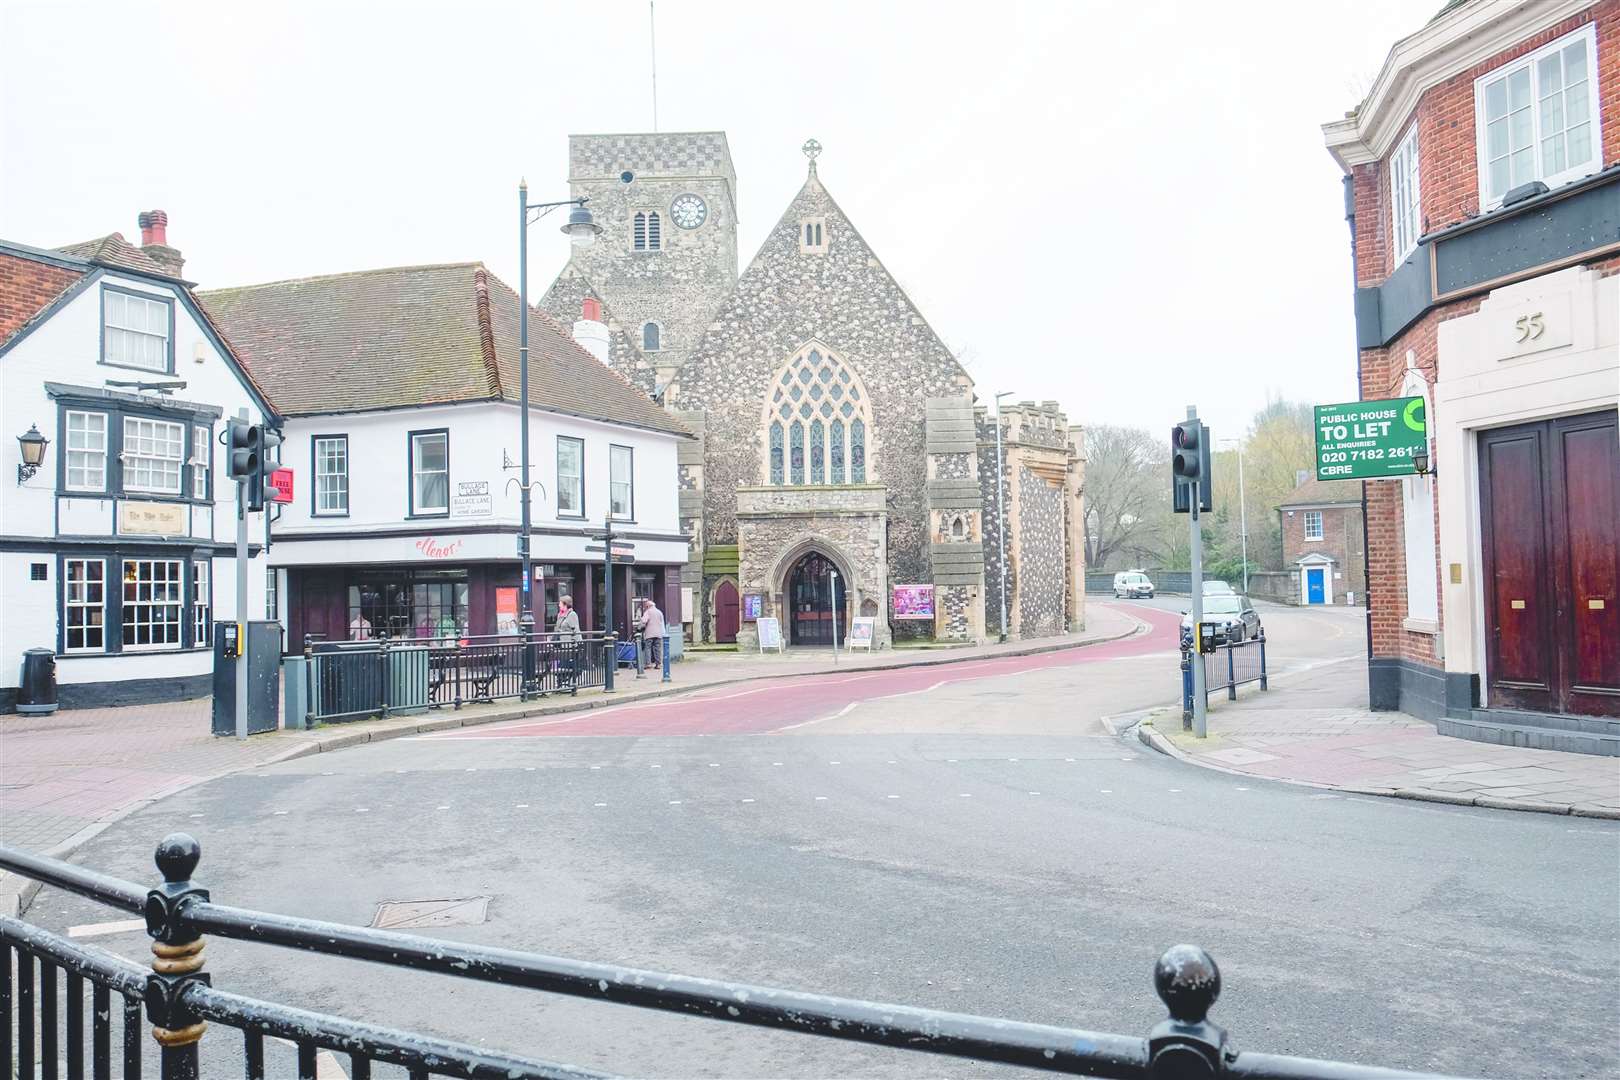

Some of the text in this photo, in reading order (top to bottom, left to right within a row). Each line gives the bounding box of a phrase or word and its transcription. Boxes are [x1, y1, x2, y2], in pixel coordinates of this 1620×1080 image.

[1515, 311, 1545, 344] 55
[1320, 410, 1397, 424] PUBLIC HOUSE
[1320, 421, 1391, 441] TO LET
[1336, 440, 1377, 450] ENQUIRIES
[1321, 452, 1347, 463] 020
[1350, 449, 1384, 460] 7182
[1320, 465, 1353, 475] CBRE
